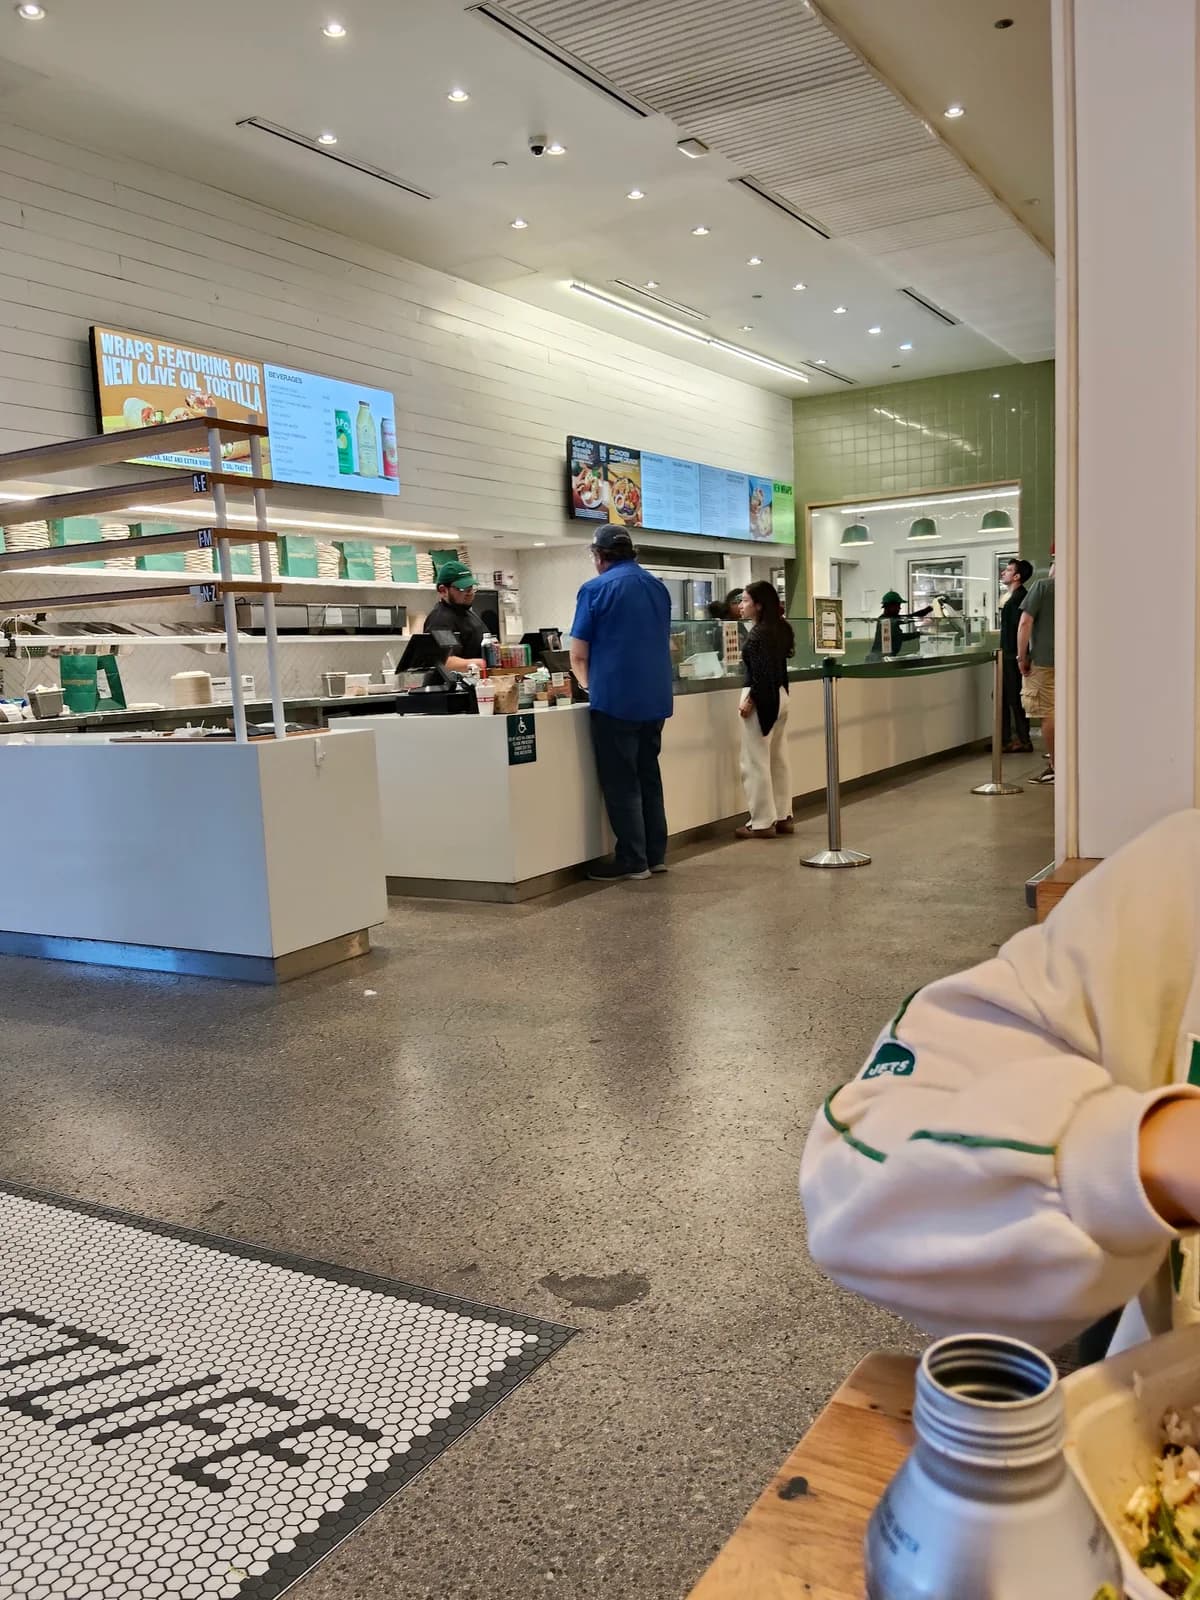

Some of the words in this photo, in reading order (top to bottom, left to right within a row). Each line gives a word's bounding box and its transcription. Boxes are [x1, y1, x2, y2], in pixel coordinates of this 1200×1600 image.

[100, 332, 154, 363] WRAPS
[157, 345, 231, 379] FEATURING
[235, 362, 260, 385] OUR
[102, 355, 133, 386] NEW
[137, 362, 176, 387] OLIVE
[180, 370, 201, 392] OIL
[203, 375, 263, 414] TORTILLA
[268, 371, 303, 384] BEVERAGES
[868, 1060, 910, 1076] JETS
